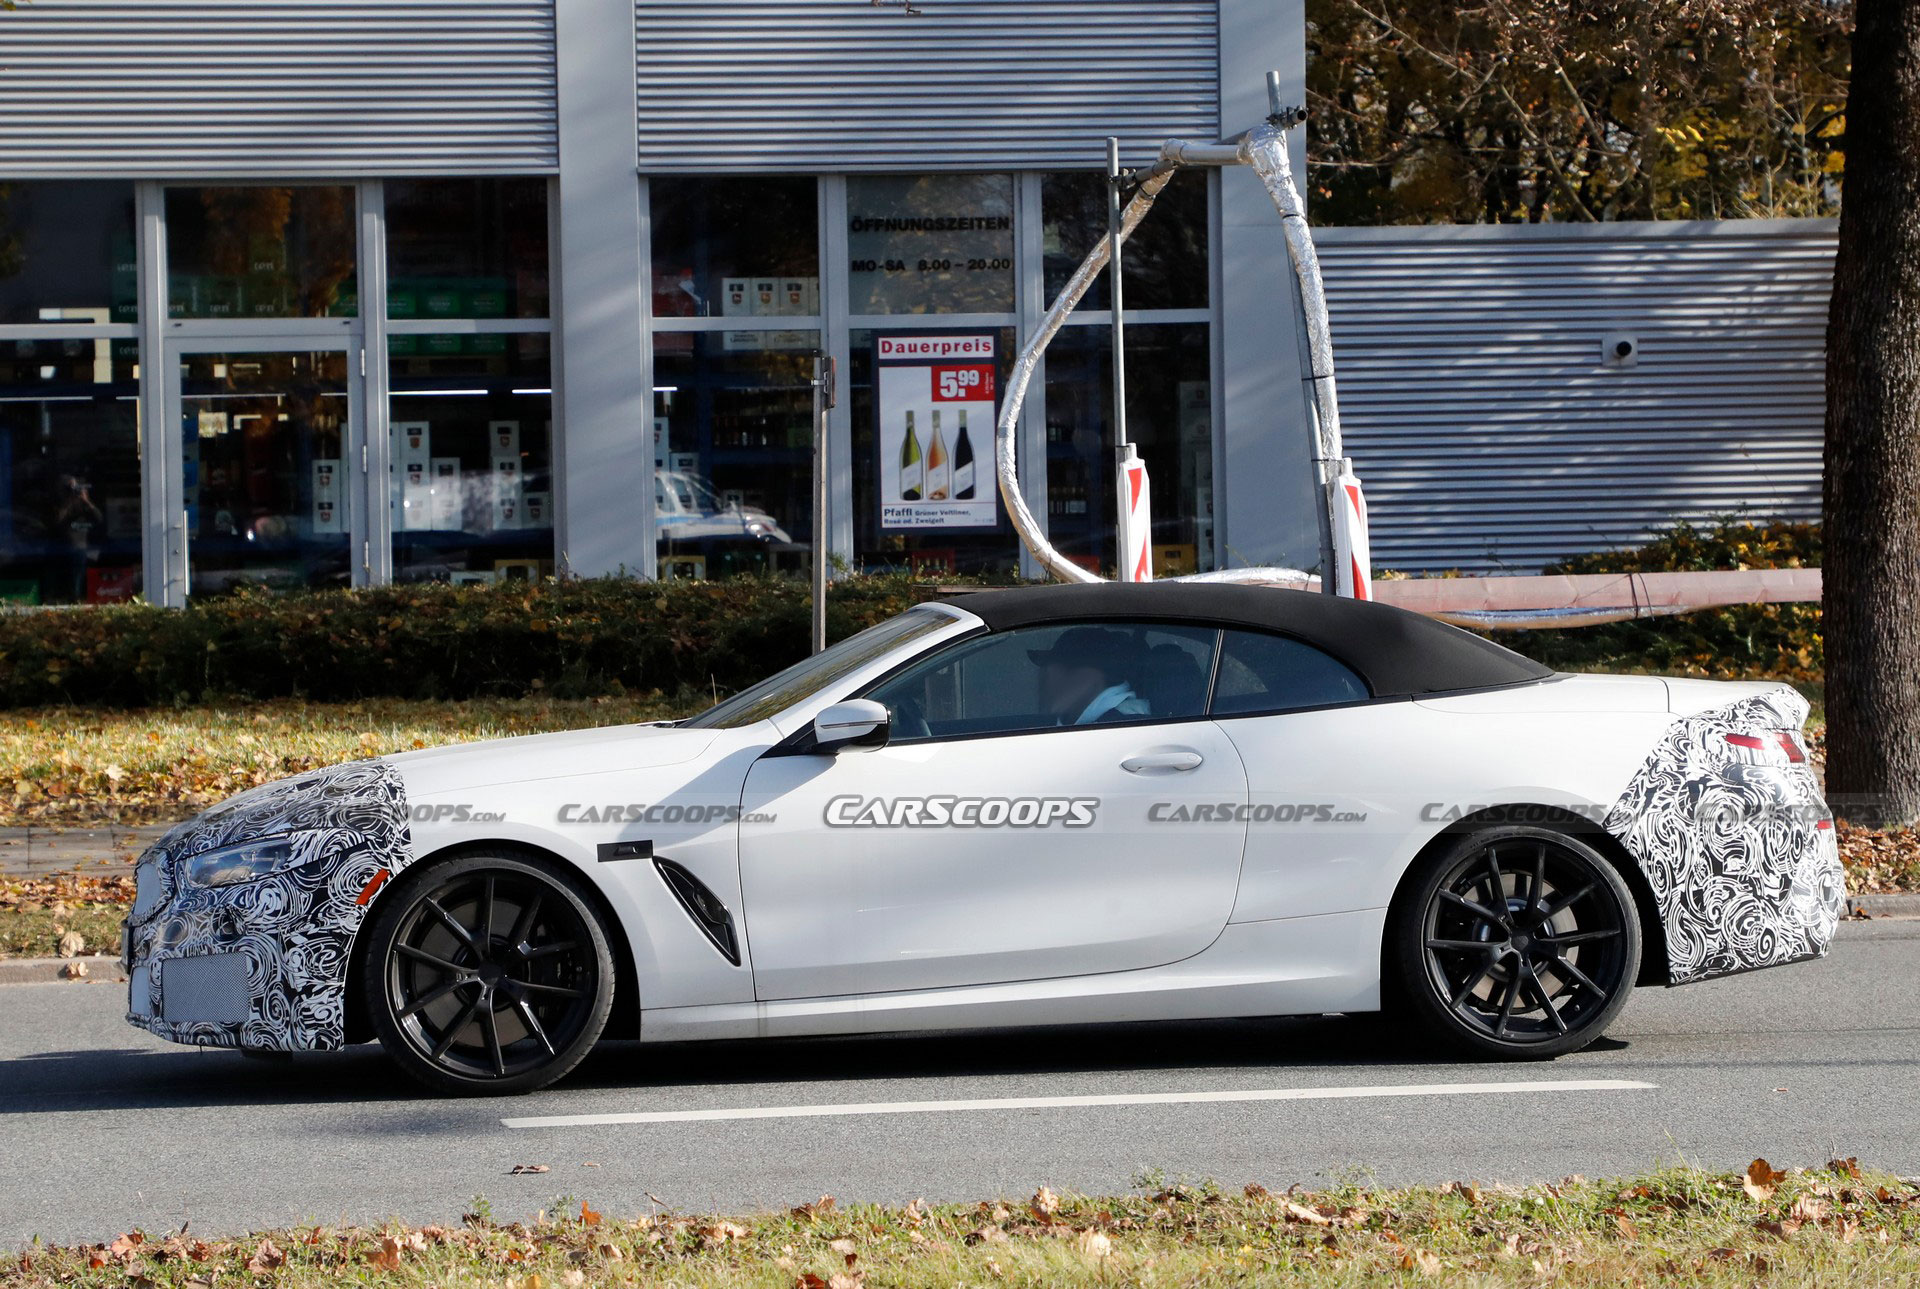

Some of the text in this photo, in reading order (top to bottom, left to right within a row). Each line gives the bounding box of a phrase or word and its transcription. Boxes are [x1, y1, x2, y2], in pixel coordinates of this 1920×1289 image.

[851, 215, 1010, 232] ÖFFNUNGSZEITEN
[918, 259, 951, 271] 8.00
[967, 258, 1011, 270] 20.00
[881, 338, 992, 355] Dauerpreis
[884, 508, 913, 517] Pfaffl
[915, 517, 945, 525] Zweigelt
